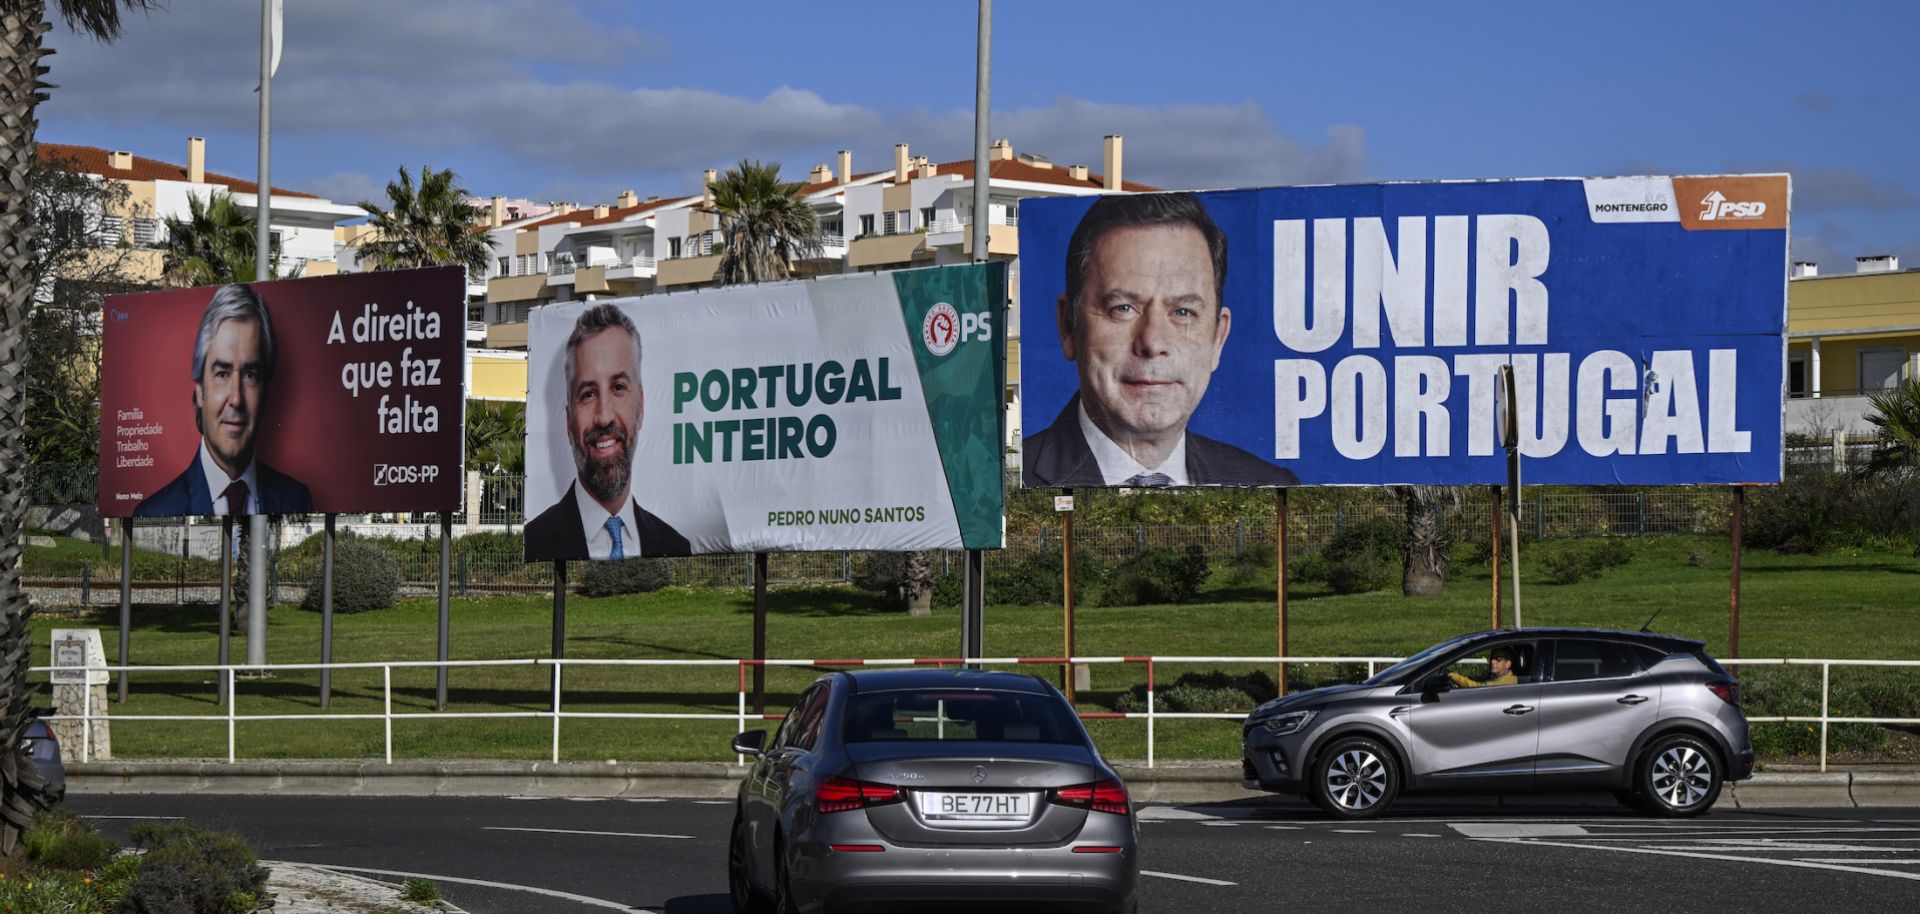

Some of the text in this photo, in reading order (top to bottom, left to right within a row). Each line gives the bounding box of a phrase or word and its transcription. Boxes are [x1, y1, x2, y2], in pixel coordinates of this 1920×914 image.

[1595, 203, 1669, 213] MONTENEGRO
[1719, 202, 1766, 216] PSD
[1273, 215, 1551, 353] UNIR
[327, 300, 441, 345] A direita
[961, 311, 992, 342] PS
[342, 347, 441, 397] que faz
[674, 356, 902, 414] PORTUGAL
[117, 408, 143, 420] Família
[378, 394, 438, 433] falta
[1274, 349, 1752, 460] PORTUGAL
[117, 424, 163, 437] Propriedade
[673, 414, 837, 465] INTEIRO
[117, 439, 148, 451] Trabalho
[117, 455, 153, 467] Liberdade
[388, 466, 439, 483] CDS-PP
[130, 492, 143, 500] Melo
[767, 506, 925, 527] PEDRO NUNO SANTOS
